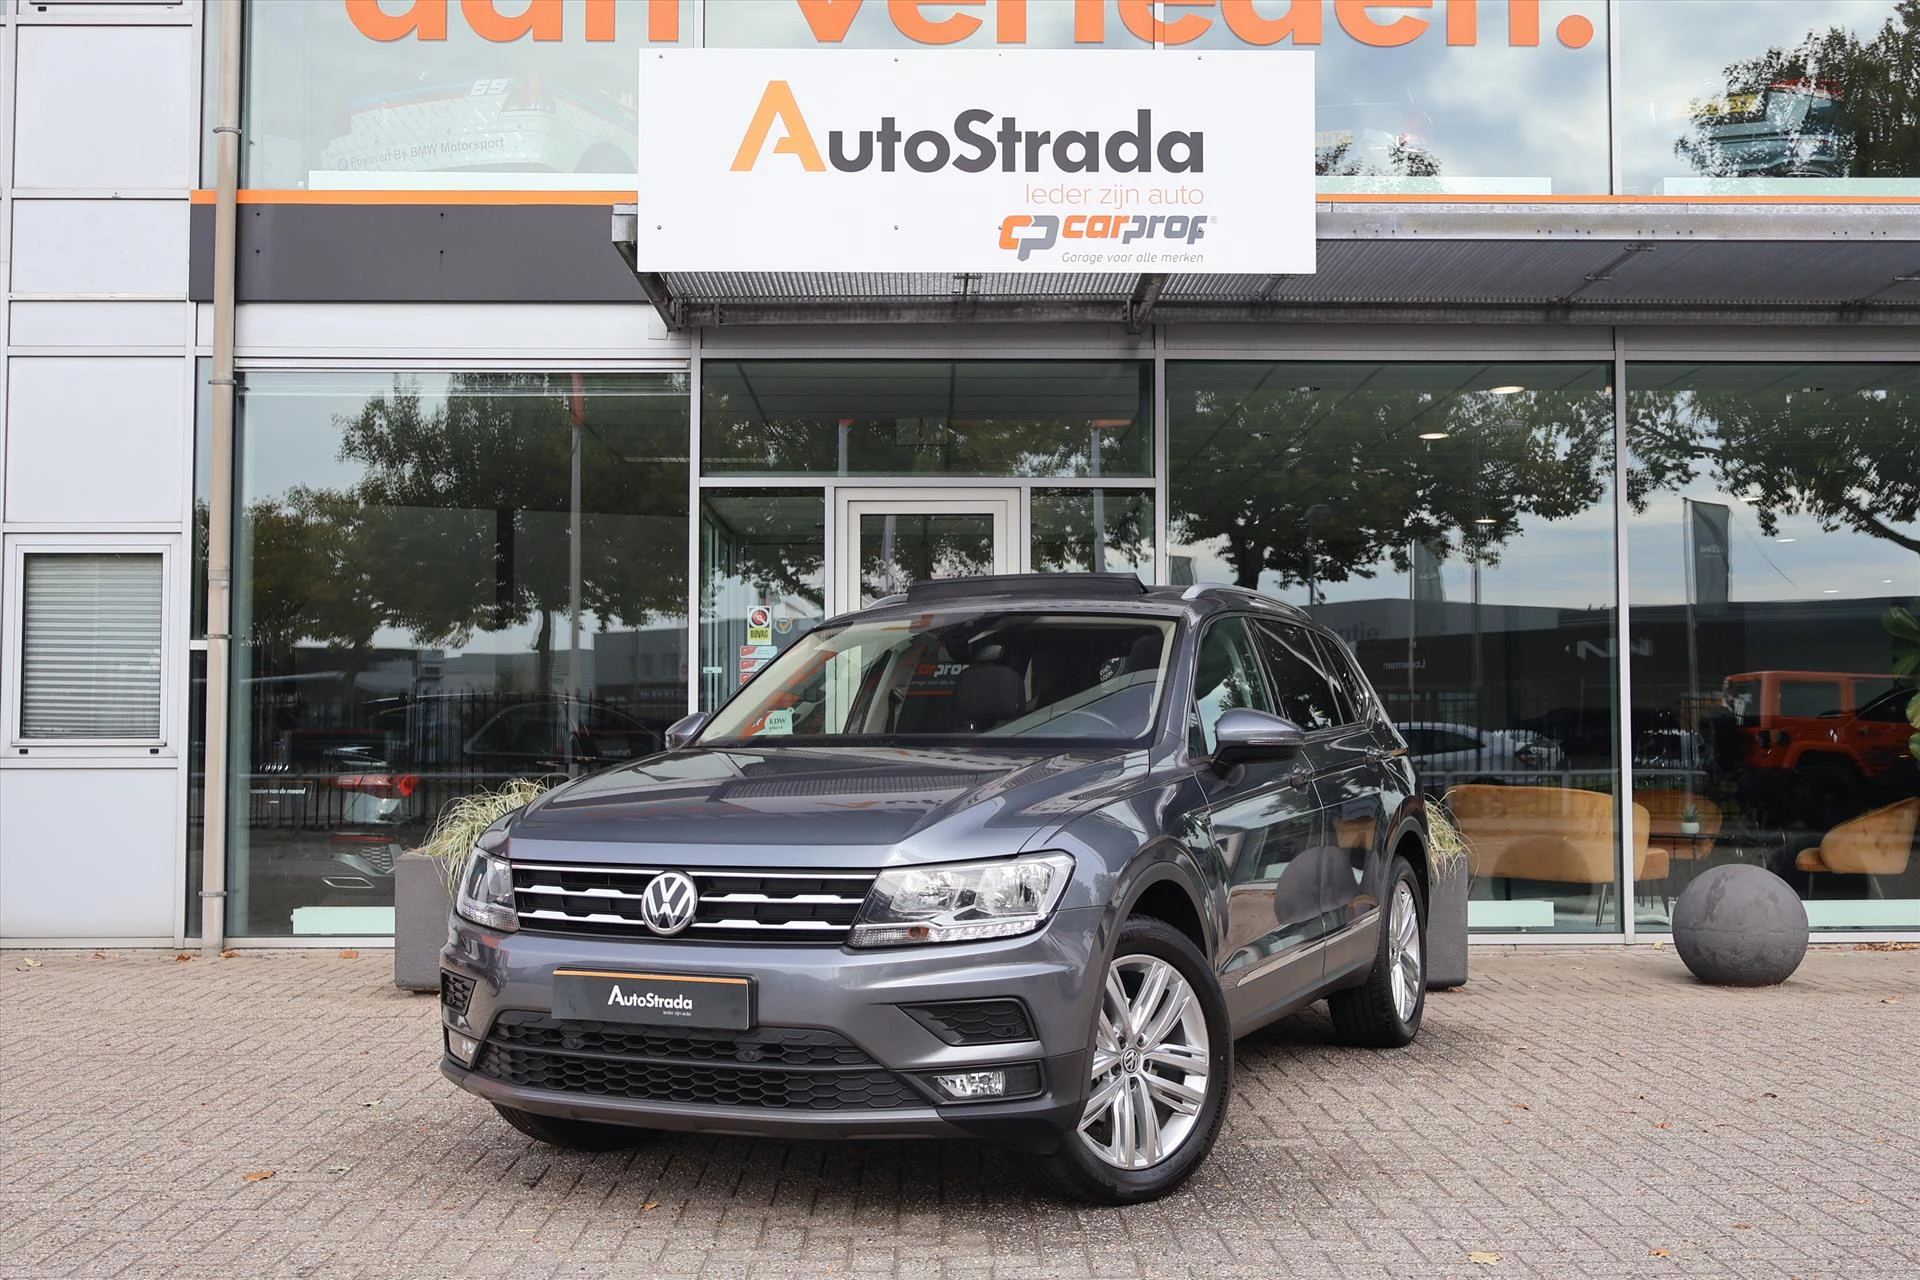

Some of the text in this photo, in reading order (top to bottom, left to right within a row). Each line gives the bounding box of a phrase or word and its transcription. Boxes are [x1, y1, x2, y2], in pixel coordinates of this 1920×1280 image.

[729, 80, 1205, 174] AutoStrada
[394, 149, 407, 163] By
[410, 143, 438, 158] BMW
[441, 137, 505, 154] Motorsport
[1026, 184, 1205, 210] Ieder zijn auto
[1061, 252, 1204, 265] Garage voor alle merken
[750, 630, 769, 639] BOVAG
[280, 787, 286, 795] de
[607, 984, 693, 1010] AutoStrada
